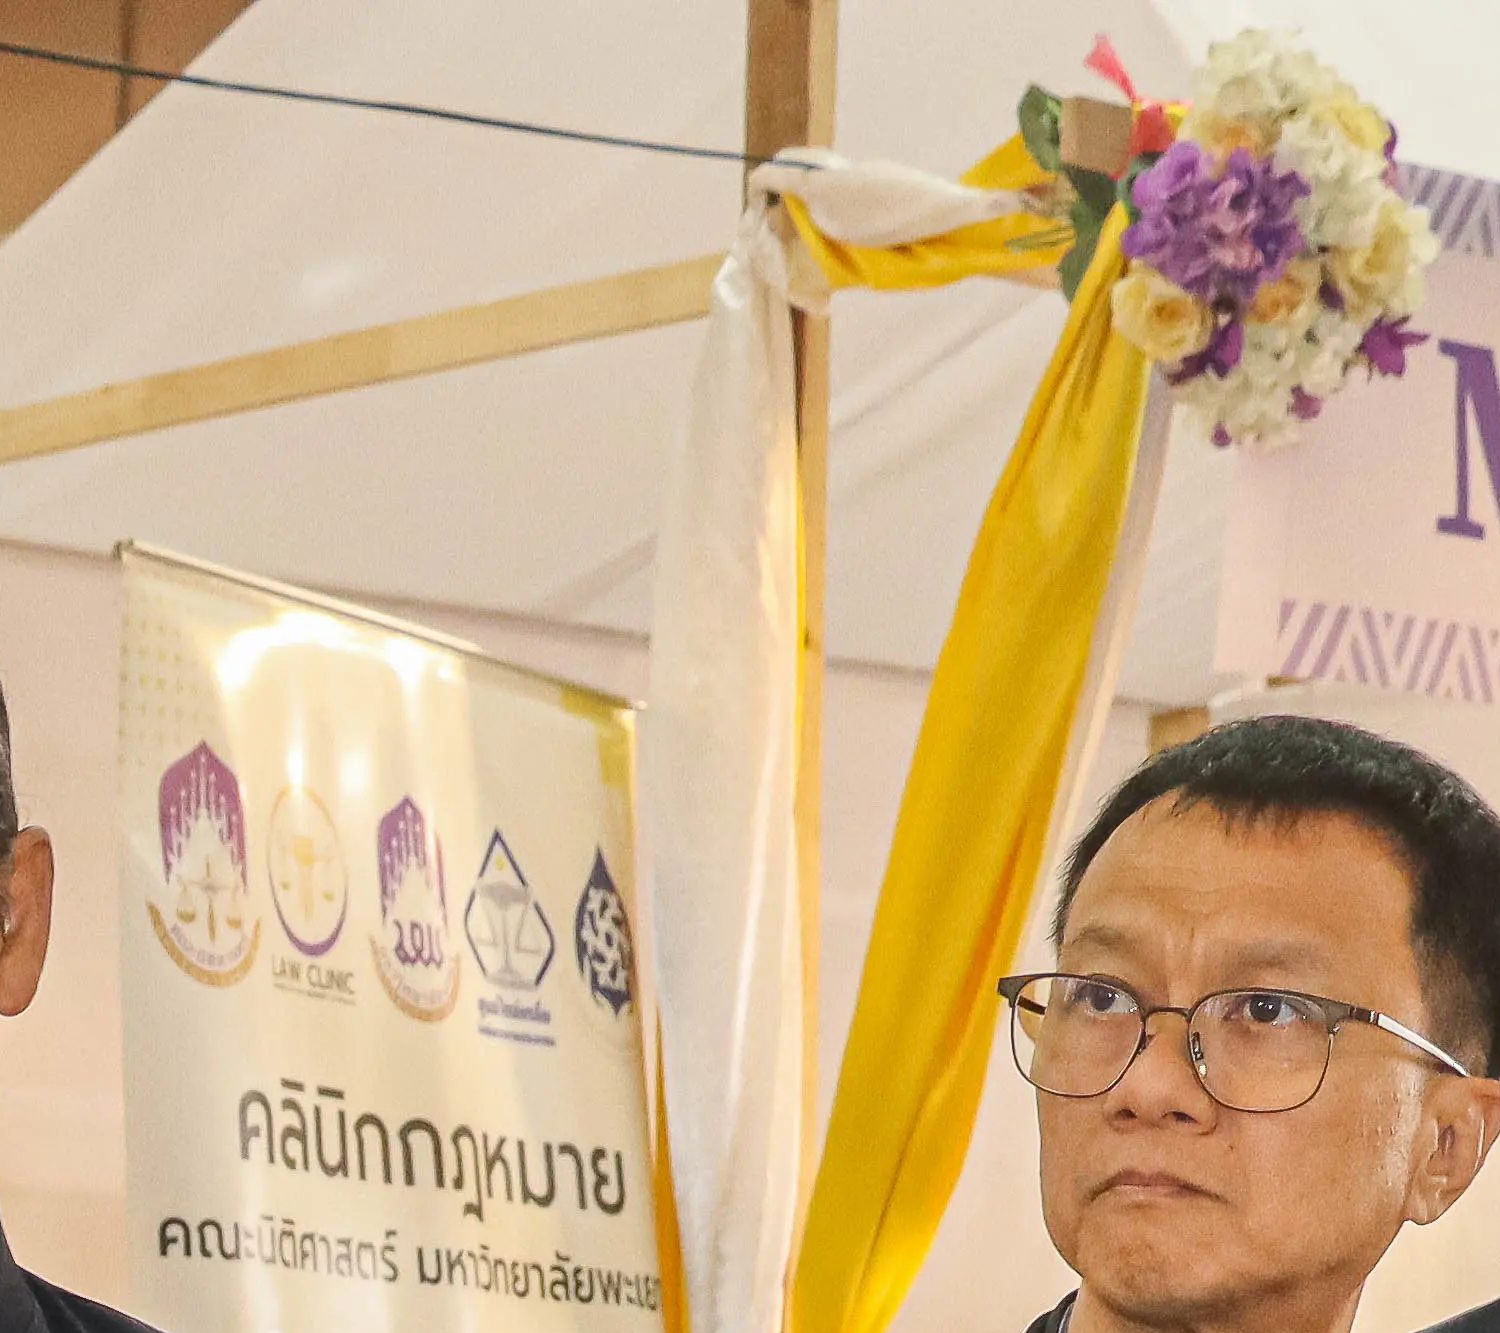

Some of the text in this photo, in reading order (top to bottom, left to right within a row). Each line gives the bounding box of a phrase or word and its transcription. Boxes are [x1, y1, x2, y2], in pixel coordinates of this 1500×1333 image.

[237, 1077, 627, 1222] คลินิกกฎหมาย
[158, 1214, 661, 1312] คณะนิติศาสตร์ มหาวิทยาลัยพะเย
